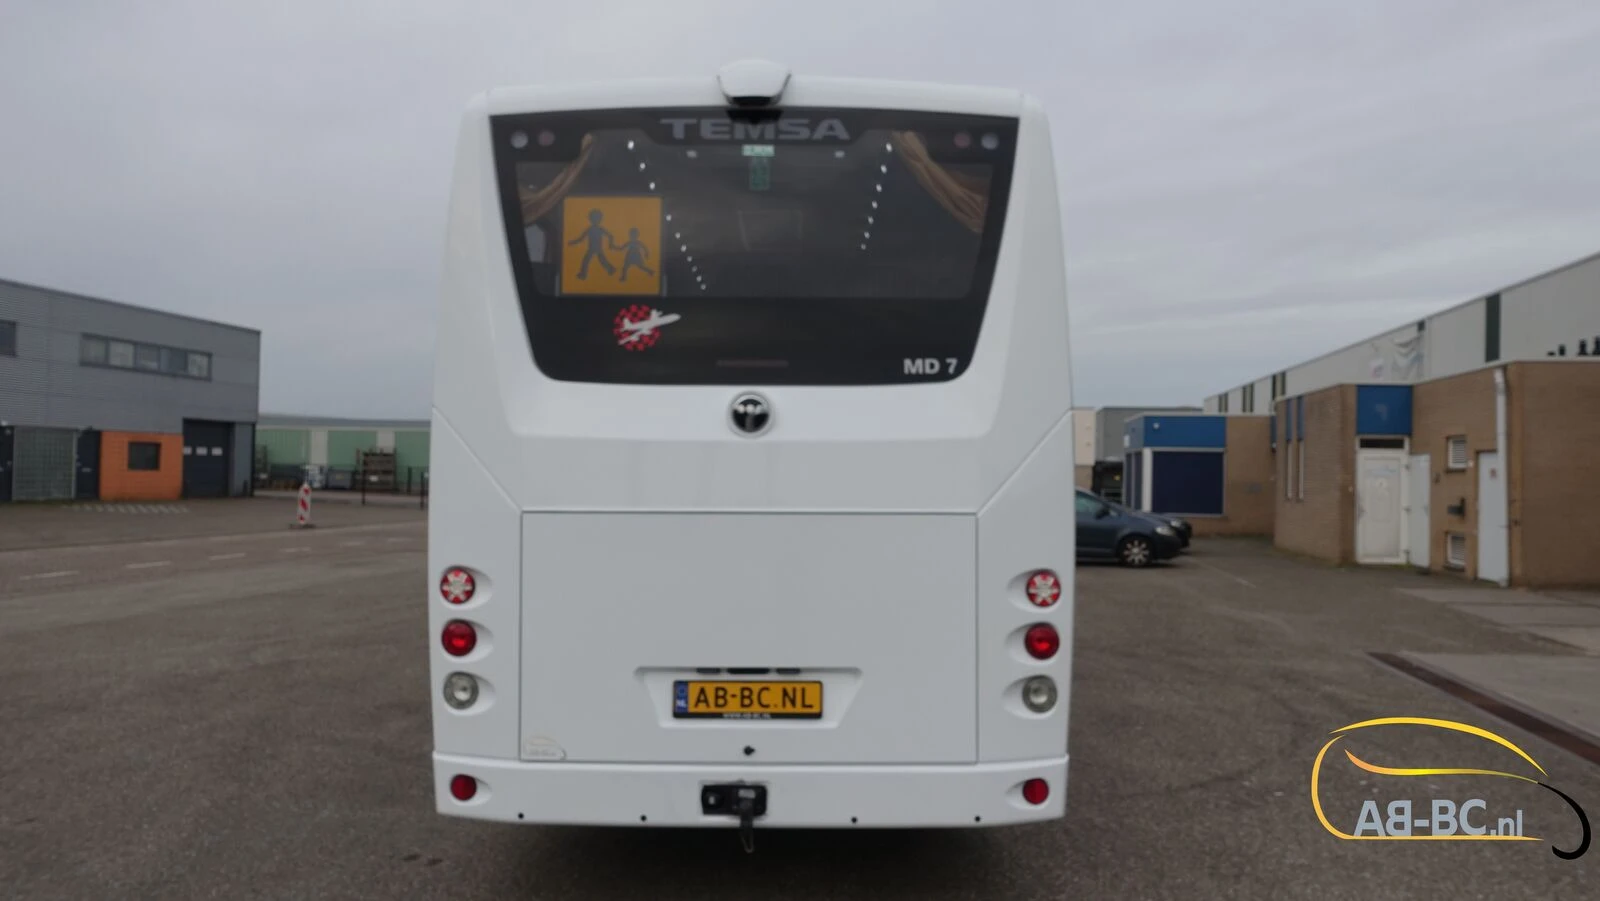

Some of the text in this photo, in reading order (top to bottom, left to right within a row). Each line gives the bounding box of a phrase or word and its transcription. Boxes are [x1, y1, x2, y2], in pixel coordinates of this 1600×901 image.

[660, 118, 850, 140] TEMSA
[903, 358, 958, 375] MD 7
[694, 687, 814, 708] AB-BC.NL
